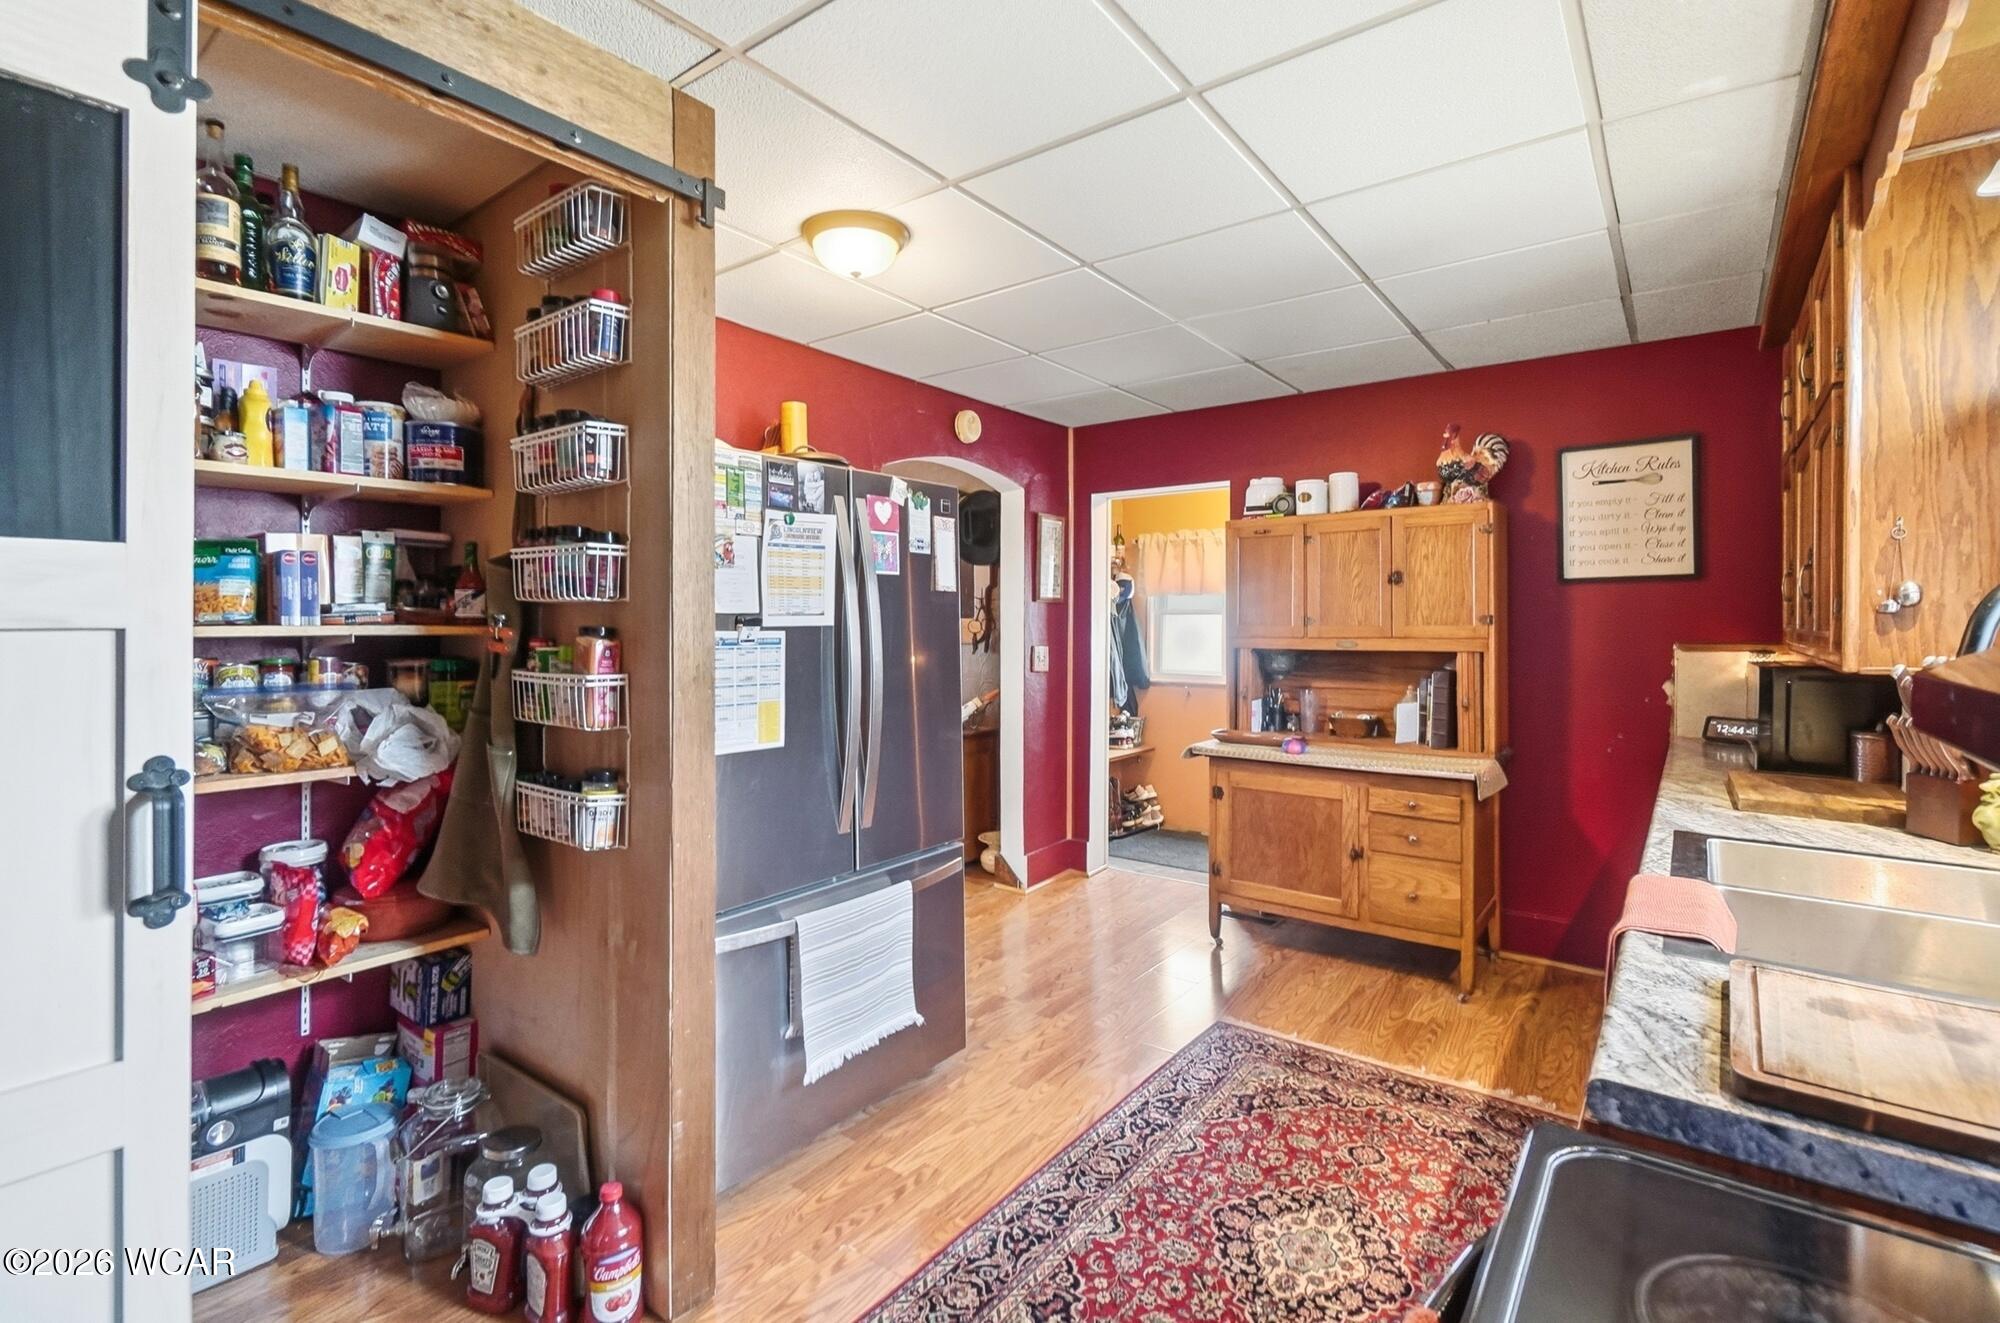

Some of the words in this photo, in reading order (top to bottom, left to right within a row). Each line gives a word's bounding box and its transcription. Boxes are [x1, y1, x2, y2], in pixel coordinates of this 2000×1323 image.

[1573, 460, 1630, 479] Kitchen
[1635, 456, 1681, 472] Rules
[1646, 492, 1674, 506] Fill
[1676, 493, 1686, 502] it
[1644, 507, 1674, 519] Clean
[1677, 508, 1686, 517] it
[1641, 521, 1667, 535] Wipe
[1645, 537, 1673, 549] Close
[1677, 538, 1686, 547] it
[194, 556, 218, 564] norr
[1641, 552, 1674, 565] Share
[1677, 553, 1686, 563] it
